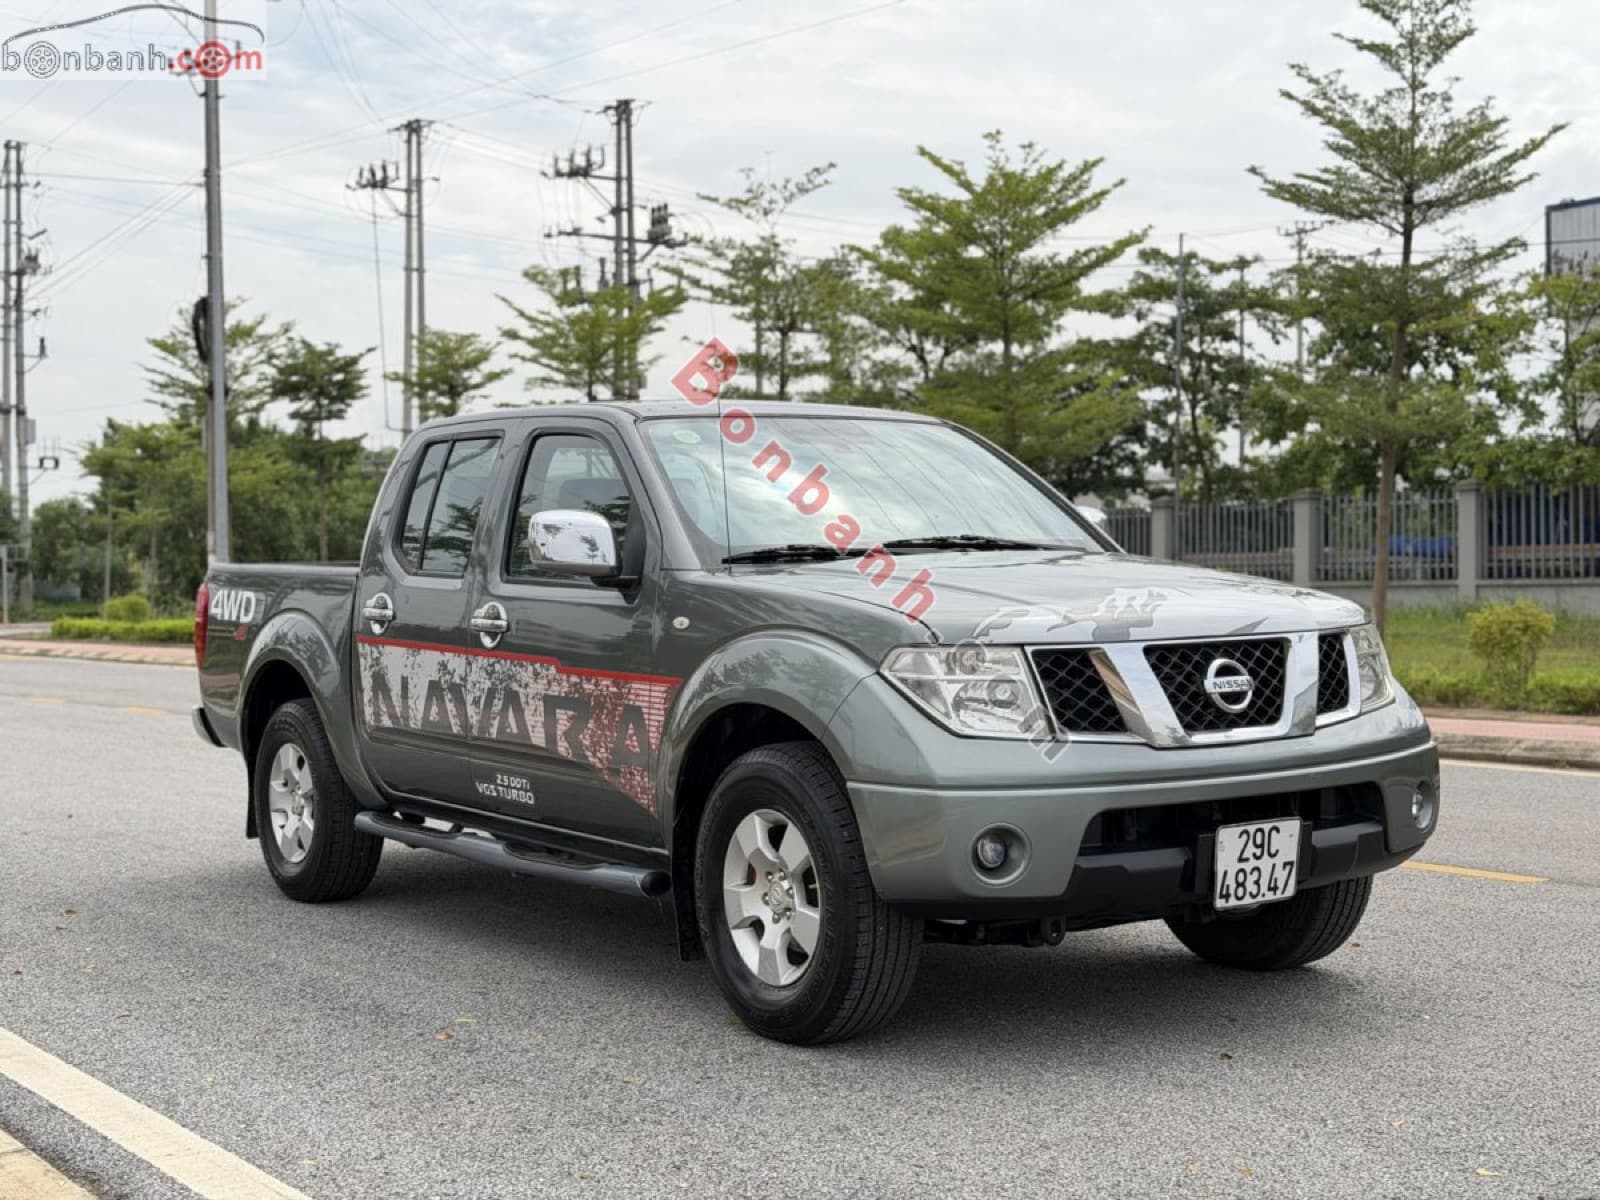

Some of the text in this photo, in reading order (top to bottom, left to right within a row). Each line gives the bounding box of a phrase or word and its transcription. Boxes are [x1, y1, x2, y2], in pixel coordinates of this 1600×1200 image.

[210, 589, 256, 623] 4WD
[370, 669, 657, 779] NAVARA
[497, 786, 535, 804] TURBO
[1237, 825, 1281, 863] 29C
[1219, 861, 1295, 904] 483.47
